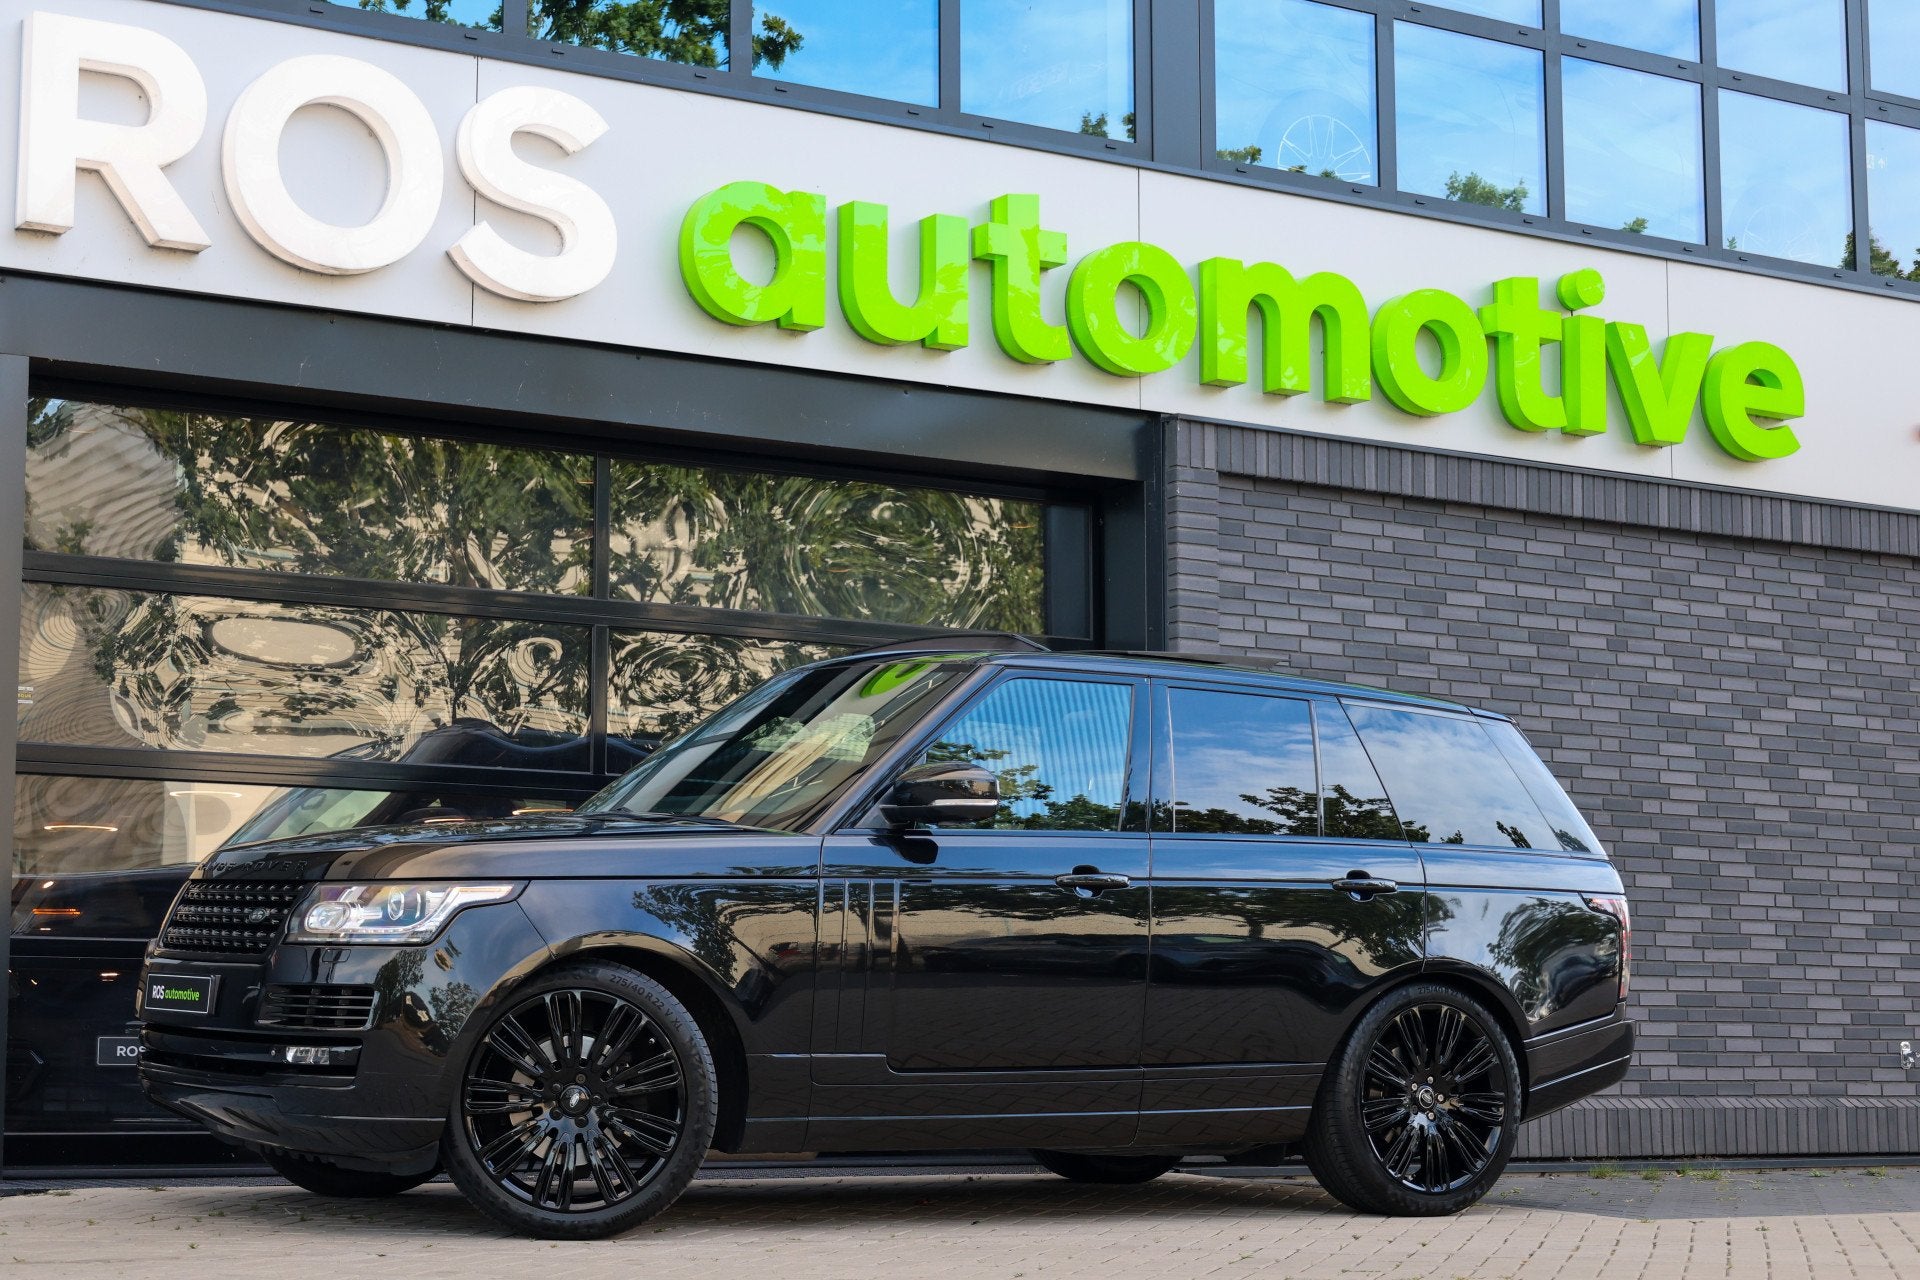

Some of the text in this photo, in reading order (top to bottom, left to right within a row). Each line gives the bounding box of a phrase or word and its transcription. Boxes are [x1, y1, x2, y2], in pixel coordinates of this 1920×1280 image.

[15, 10, 1806, 462] ROS automotive
[152, 985, 200, 1001] ROS automotive
[610, 974, 645, 996] 275/40
[645, 992, 654, 1002] R
[651, 997, 665, 1010] 22
